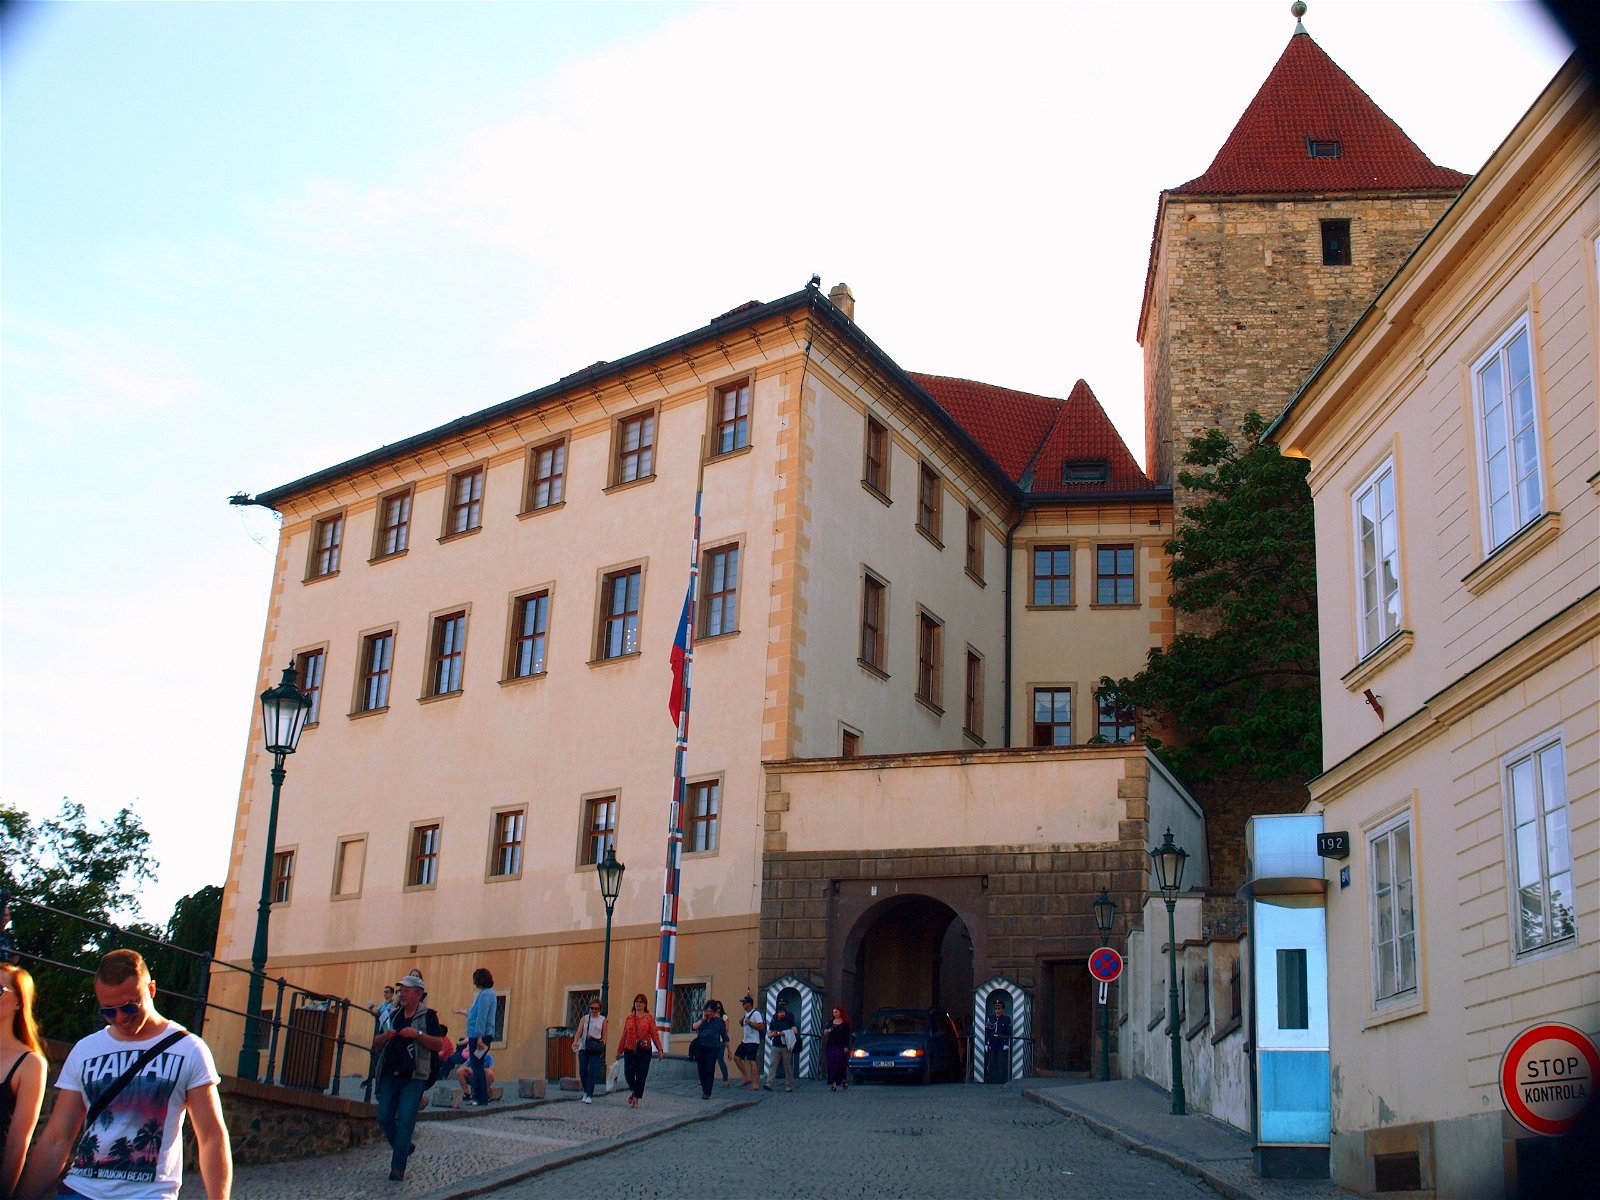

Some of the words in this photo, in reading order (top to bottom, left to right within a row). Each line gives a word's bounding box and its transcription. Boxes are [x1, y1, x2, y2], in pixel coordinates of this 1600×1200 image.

[1321, 837, 1343, 850] 192
[1527, 1057, 1579, 1078] STOP
[1525, 1083, 1585, 1103] KONTROLA
[97, 1168, 127, 1180] WAIKIKI
[126, 1171, 154, 1183] BEACH
